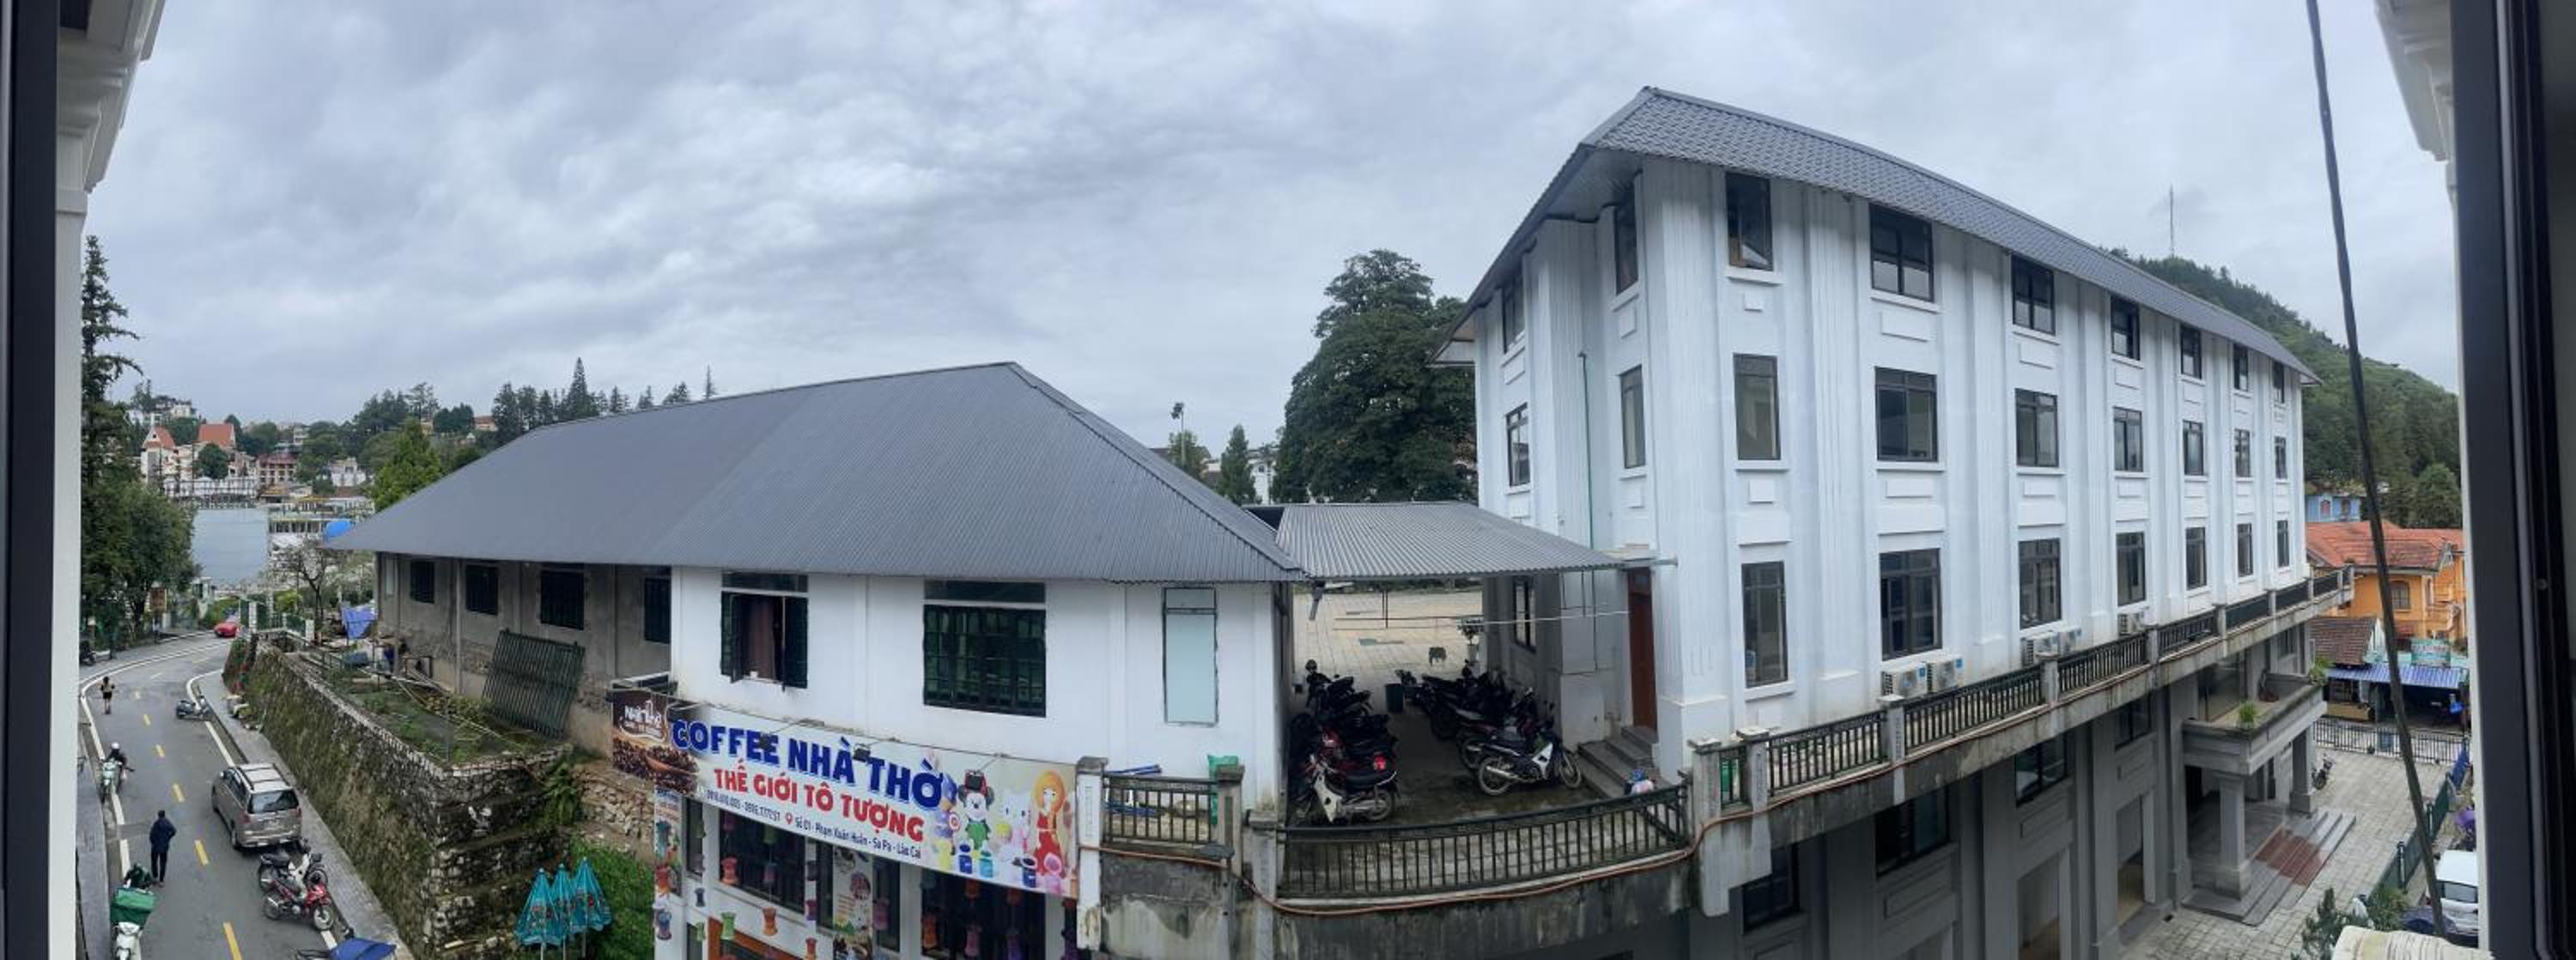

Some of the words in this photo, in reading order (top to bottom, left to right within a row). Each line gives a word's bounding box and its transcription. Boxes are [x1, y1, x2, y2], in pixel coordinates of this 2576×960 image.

[672, 720, 780, 765] COFFEE
[788, 736, 856, 785] NHÀ
[866, 756, 944, 808] THỜ
[714, 757, 748, 793] THẾ
[753, 771, 798, 804] GIỚI
[804, 781, 834, 812] TÔ
[841, 793, 925, 842] TƯỢNG
